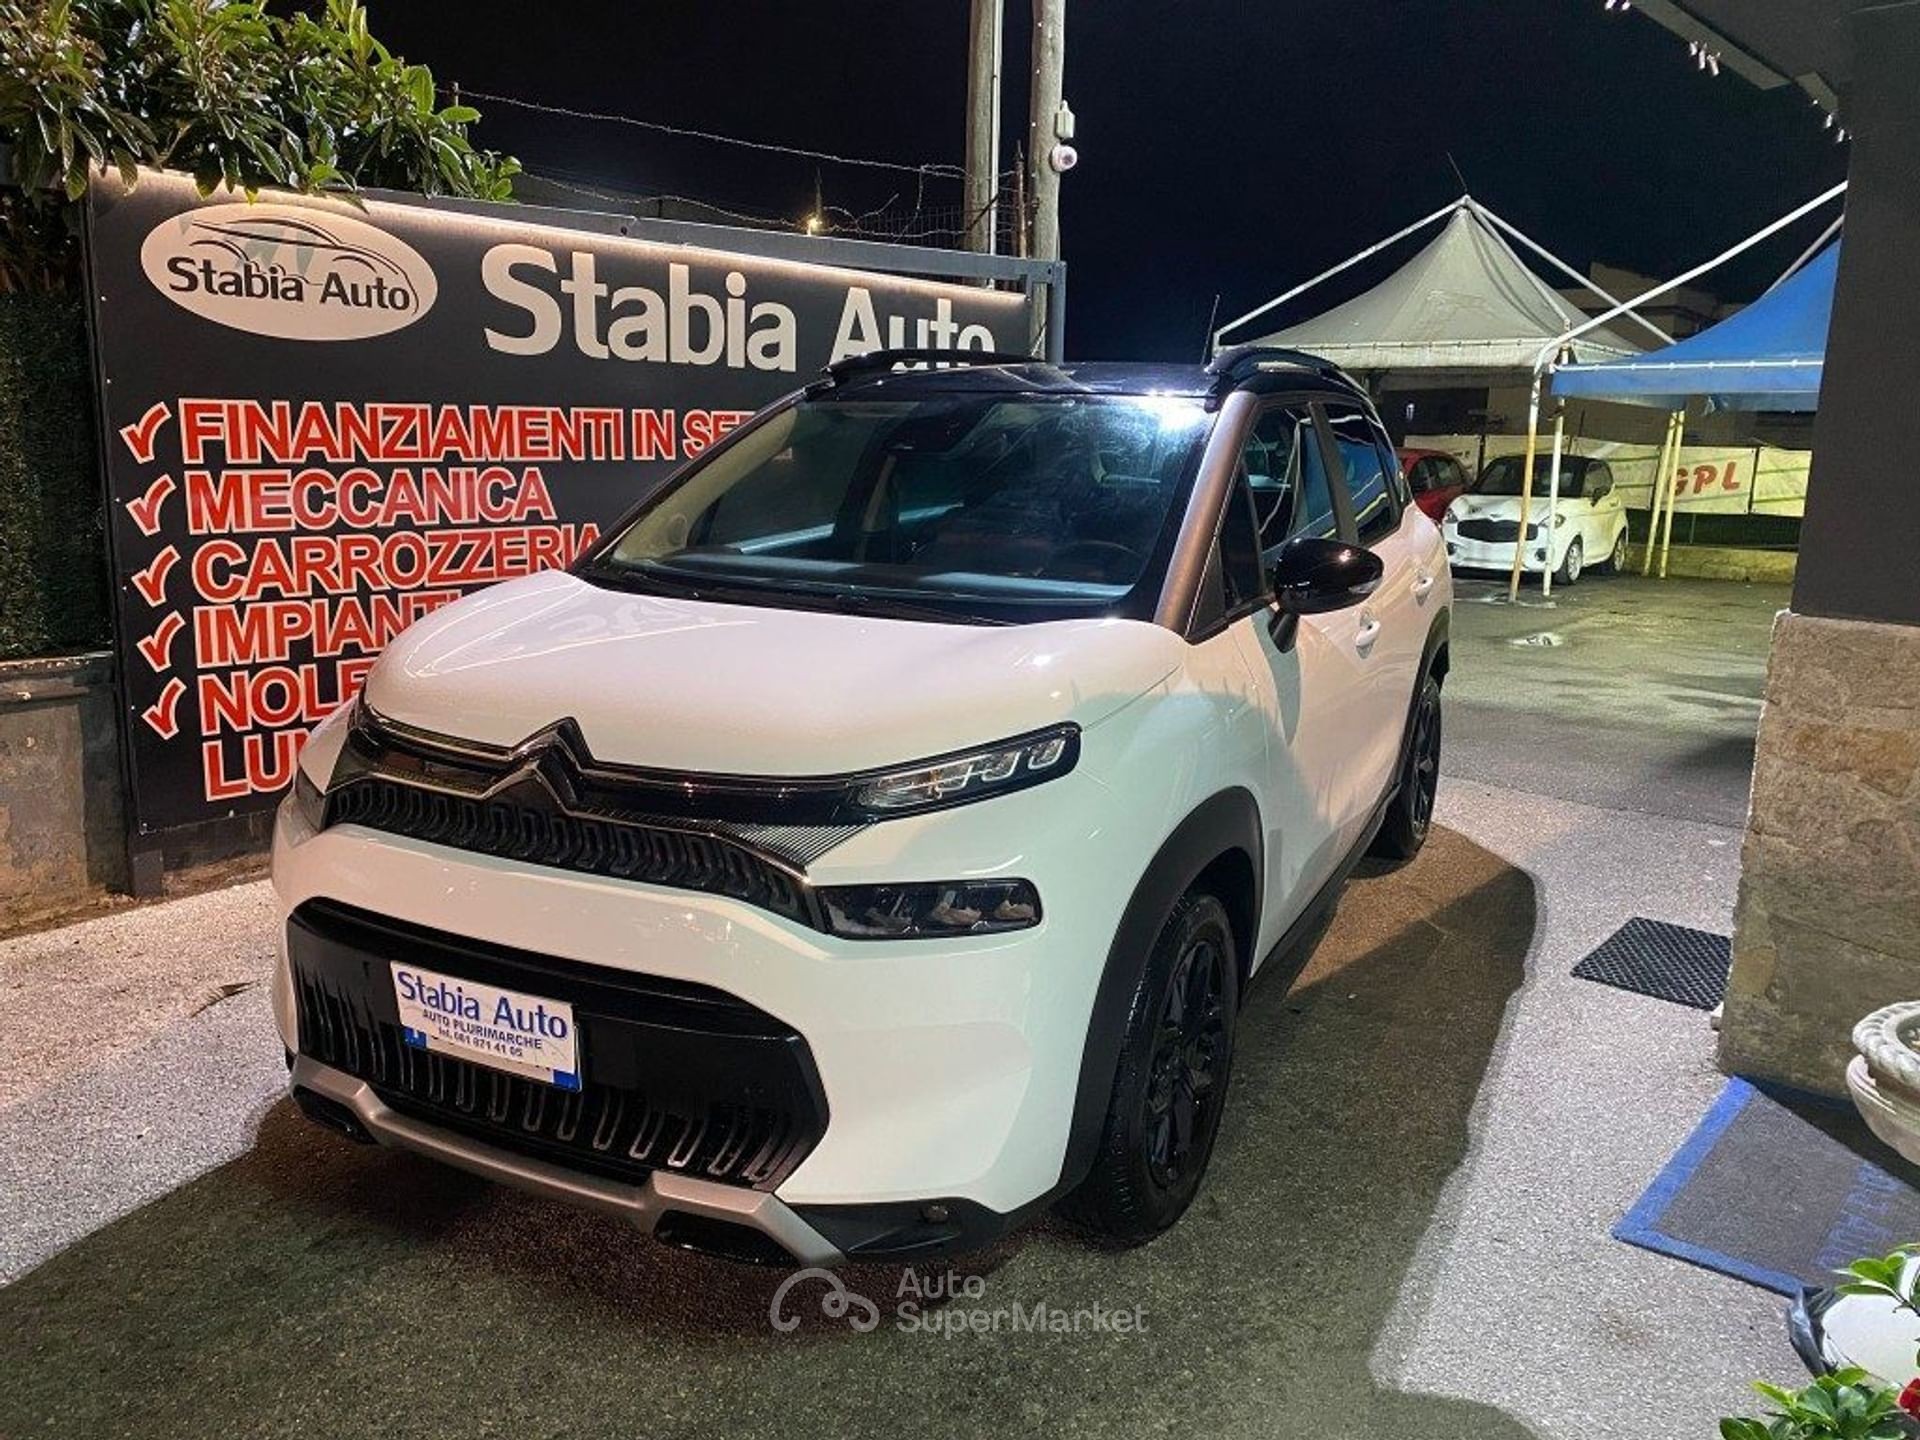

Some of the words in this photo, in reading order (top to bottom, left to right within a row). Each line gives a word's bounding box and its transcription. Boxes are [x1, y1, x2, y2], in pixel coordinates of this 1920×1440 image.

[167, 256, 303, 303] Stabia
[319, 272, 411, 312] Auto
[481, 243, 797, 373] Stabia
[829, 286, 996, 371] Auto
[178, 398, 624, 465] FINANZIAMENTI
[632, 408, 676, 461] IN
[683, 409, 756, 459] SE
[184, 467, 557, 534] MECCANICA
[192, 523, 602, 600] CARROZZERIA
[195, 589, 462, 668] IMPIANT
[203, 728, 311, 802] LU
[397, 971, 480, 1021] Stabia
[493, 996, 568, 1039] Auto
[422, 1008, 450, 1026] AUTO
[453, 1018, 543, 1050] PLURIMARCHE
